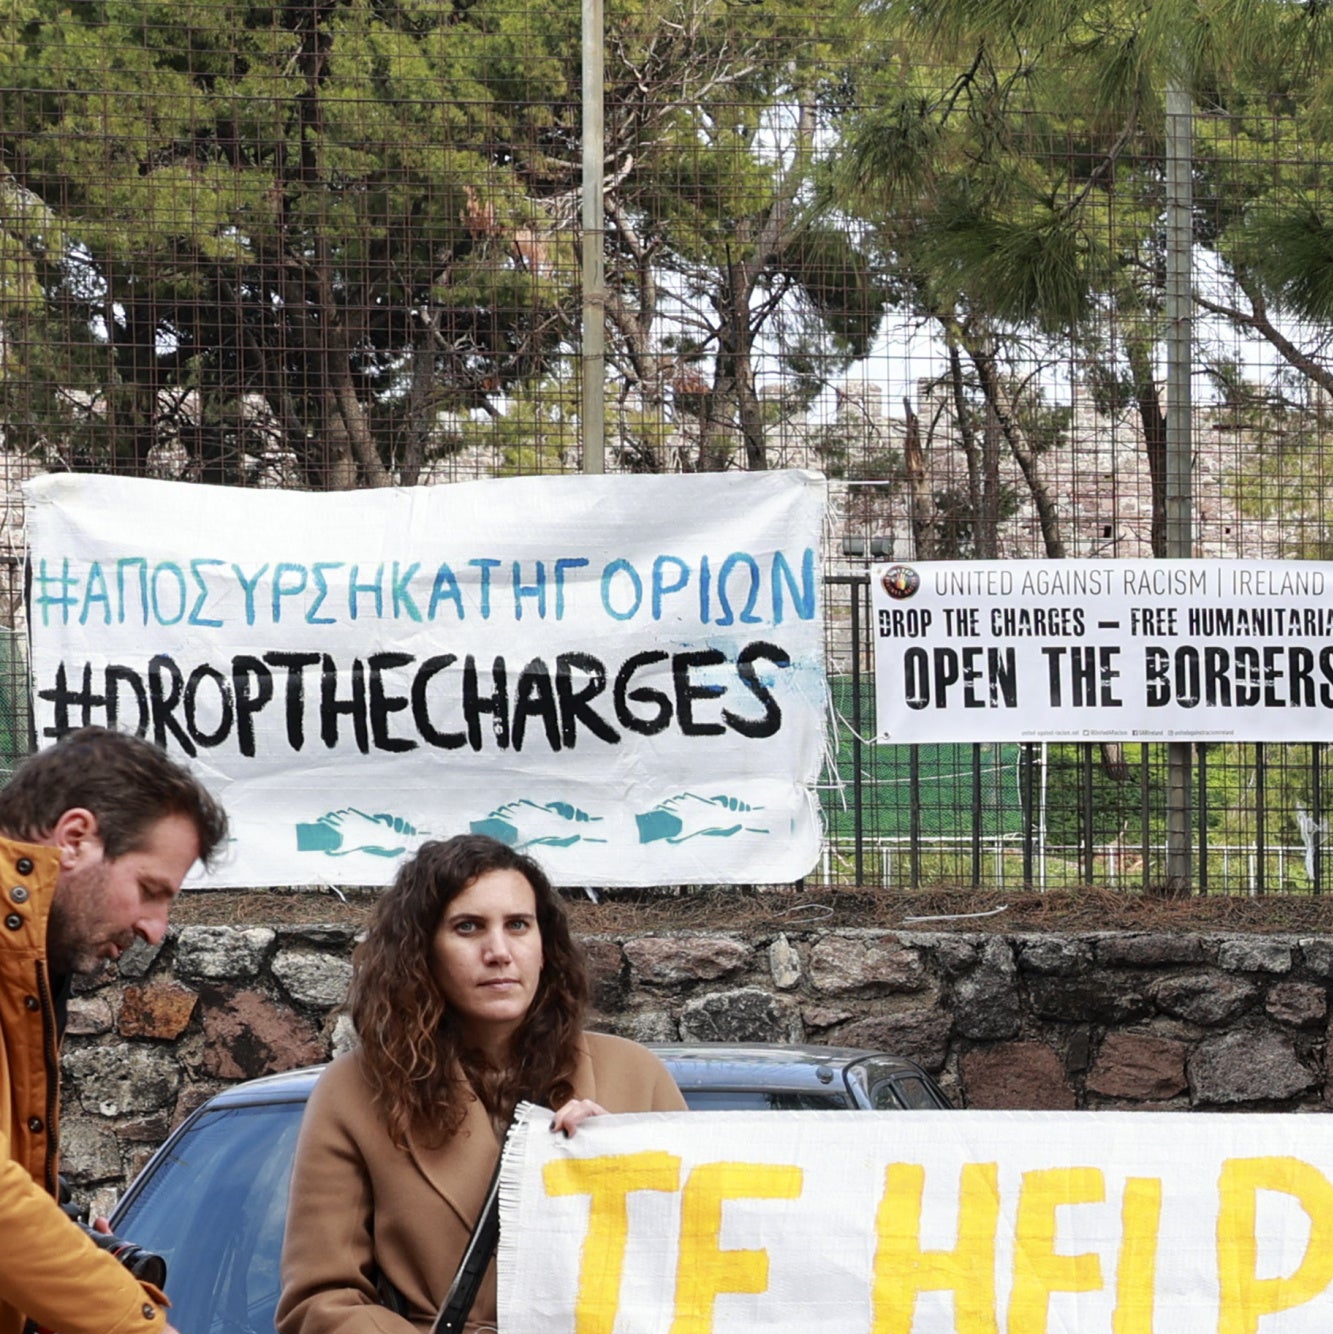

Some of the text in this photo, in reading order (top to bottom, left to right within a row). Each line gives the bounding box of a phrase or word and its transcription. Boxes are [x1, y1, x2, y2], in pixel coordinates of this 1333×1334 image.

[935, 570, 1013, 596] UNITED
[1022, 570, 1114, 596] AGAINST
[1124, 569, 1206, 596] RACISM
[1233, 570, 1325, 596] IRELAND
[879, 609, 932, 637] DROP
[943, 608, 981, 637] THE
[991, 608, 1085, 637] CHARGES
[1131, 607, 1178, 637] FREE
[38, 641, 791, 757] #DROPTHECHARGES
[904, 647, 1017, 710] OPEN
[1042, 646, 1122, 709] THE
